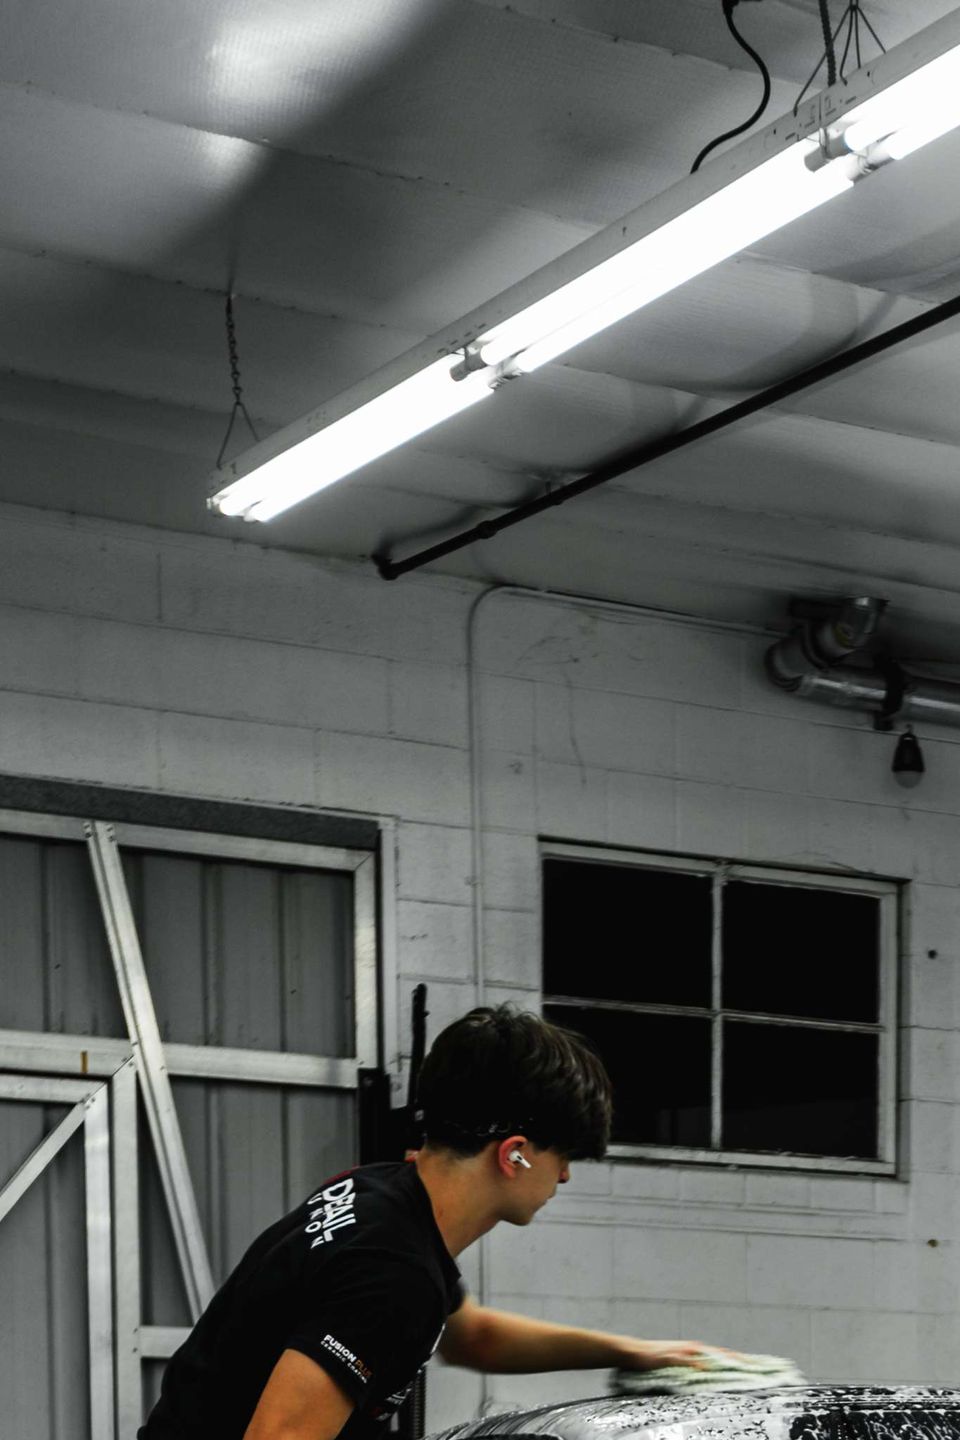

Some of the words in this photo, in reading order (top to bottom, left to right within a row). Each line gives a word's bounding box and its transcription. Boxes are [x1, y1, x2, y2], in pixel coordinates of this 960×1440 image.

[304, 1192, 326, 1249] UNON
[322, 1177, 357, 1242] DEAIL
[323, 1333, 358, 1363] FUSION
[354, 1359, 374, 1377] PLUS
